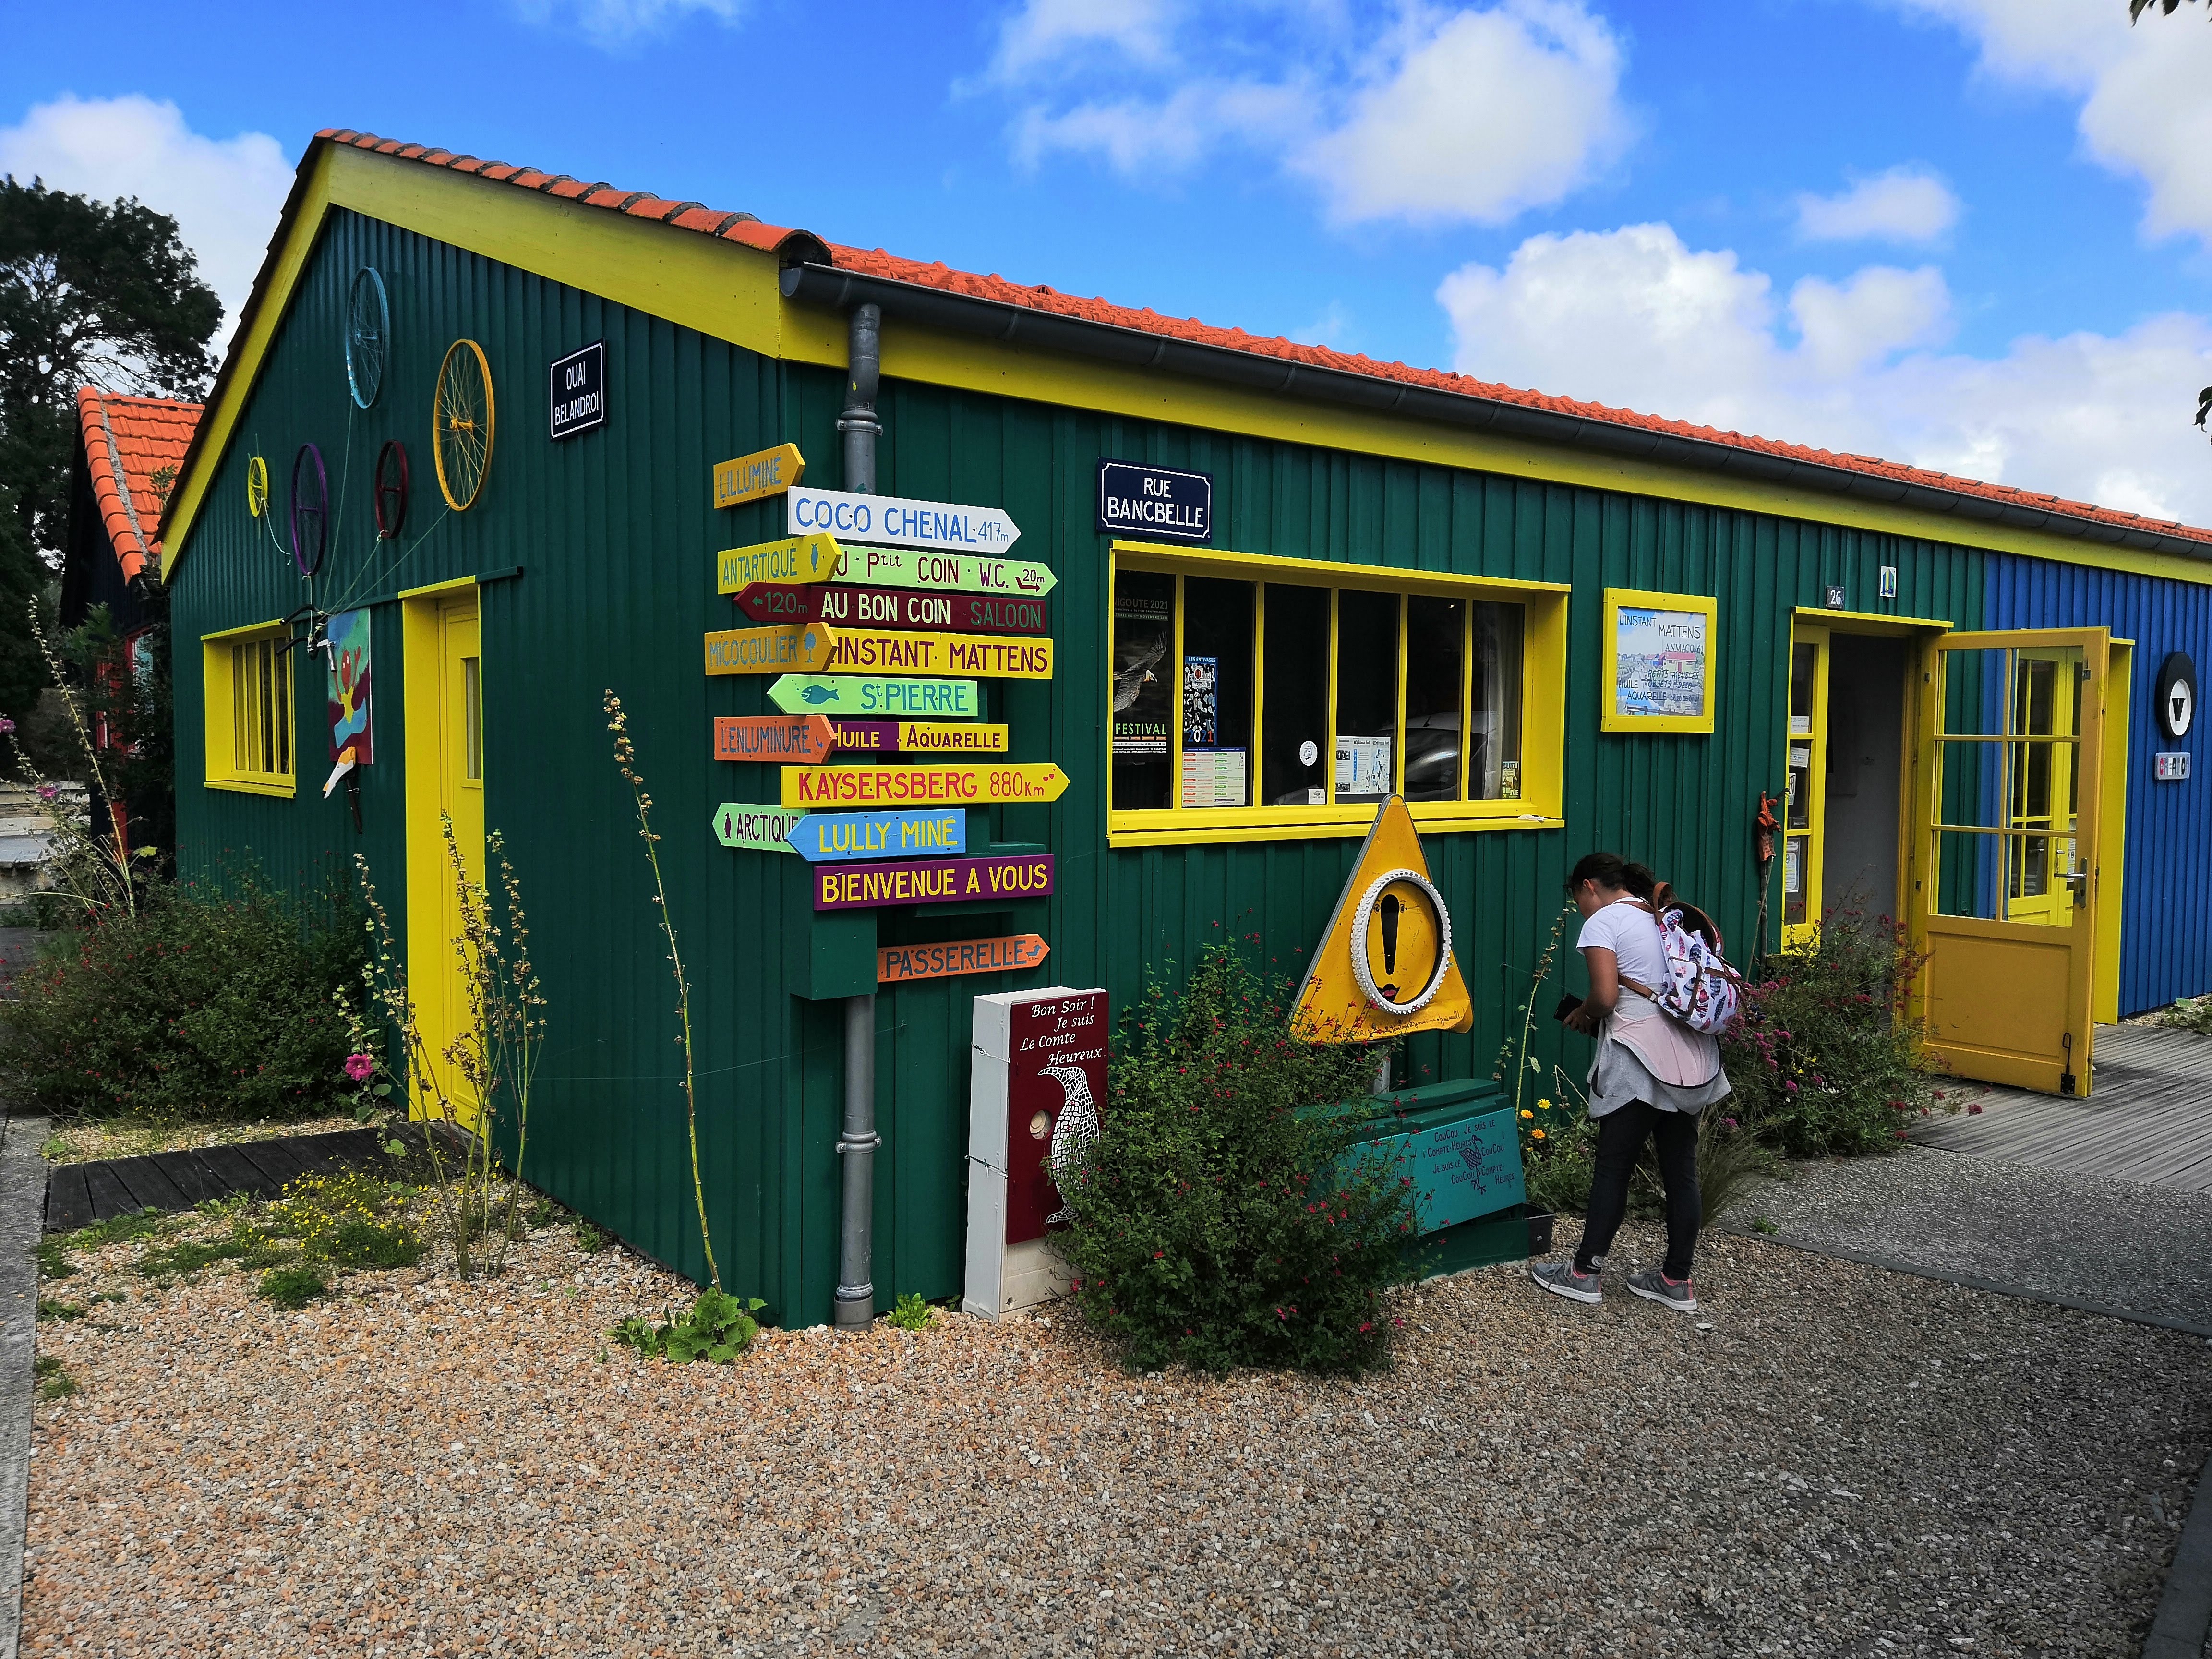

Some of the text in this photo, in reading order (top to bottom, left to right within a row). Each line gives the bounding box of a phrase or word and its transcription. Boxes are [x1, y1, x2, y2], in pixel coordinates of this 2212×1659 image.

[566, 361, 585, 390] QUAI
[555, 391, 599, 426] BELANDROI
[1144, 478, 1172, 498] RUE
[796, 498, 1009, 543] COCO CHENAL 417m
[1108, 496, 1203, 528] BANCBELLE
[722, 548, 797, 586] ANTARTIQUE
[917, 557, 959, 583] COIN
[979, 563, 1009, 589] W.C.
[1022, 569, 1045, 583] 20m
[764, 592, 1041, 629] 120m AU BON COIN SALOON
[1150, 600, 1168, 610] 2021
[1830, 589, 1841, 605] 26
[1619, 615, 1657, 627] L'INSTANT
[1658, 624, 1701, 639] MATTENS
[709, 635, 798, 667] MICOCOULIER
[832, 637, 1047, 673] INSTANT MATTENS
[885, 684, 969, 712] PIERRE
[1618, 680, 1638, 689] HUILE
[1627, 691, 1667, 700] AQUARELLE
[721, 725, 811, 753] L'ENLUMINURE
[906, 725, 1001, 748] AQUARELLE
[1116, 723, 1167, 734] FESTIVAL
[1188, 729, 1214, 742] 2021
[798, 772, 977, 801] KAYSERSBERG
[819, 816, 957, 853] LULLY MINÉ
[822, 864, 1047, 903] BIENVENUE A VOUS
[886, 940, 1027, 978] PASSERELLE
[1031, 1004, 1056, 1017] Bon
[1061, 999, 1087, 1013] Soir
[1054, 1013, 1094, 1032] Je suis
[1020, 1032, 1076, 1051] Le Comte
[1046, 1048, 1102, 1066] Heureux
